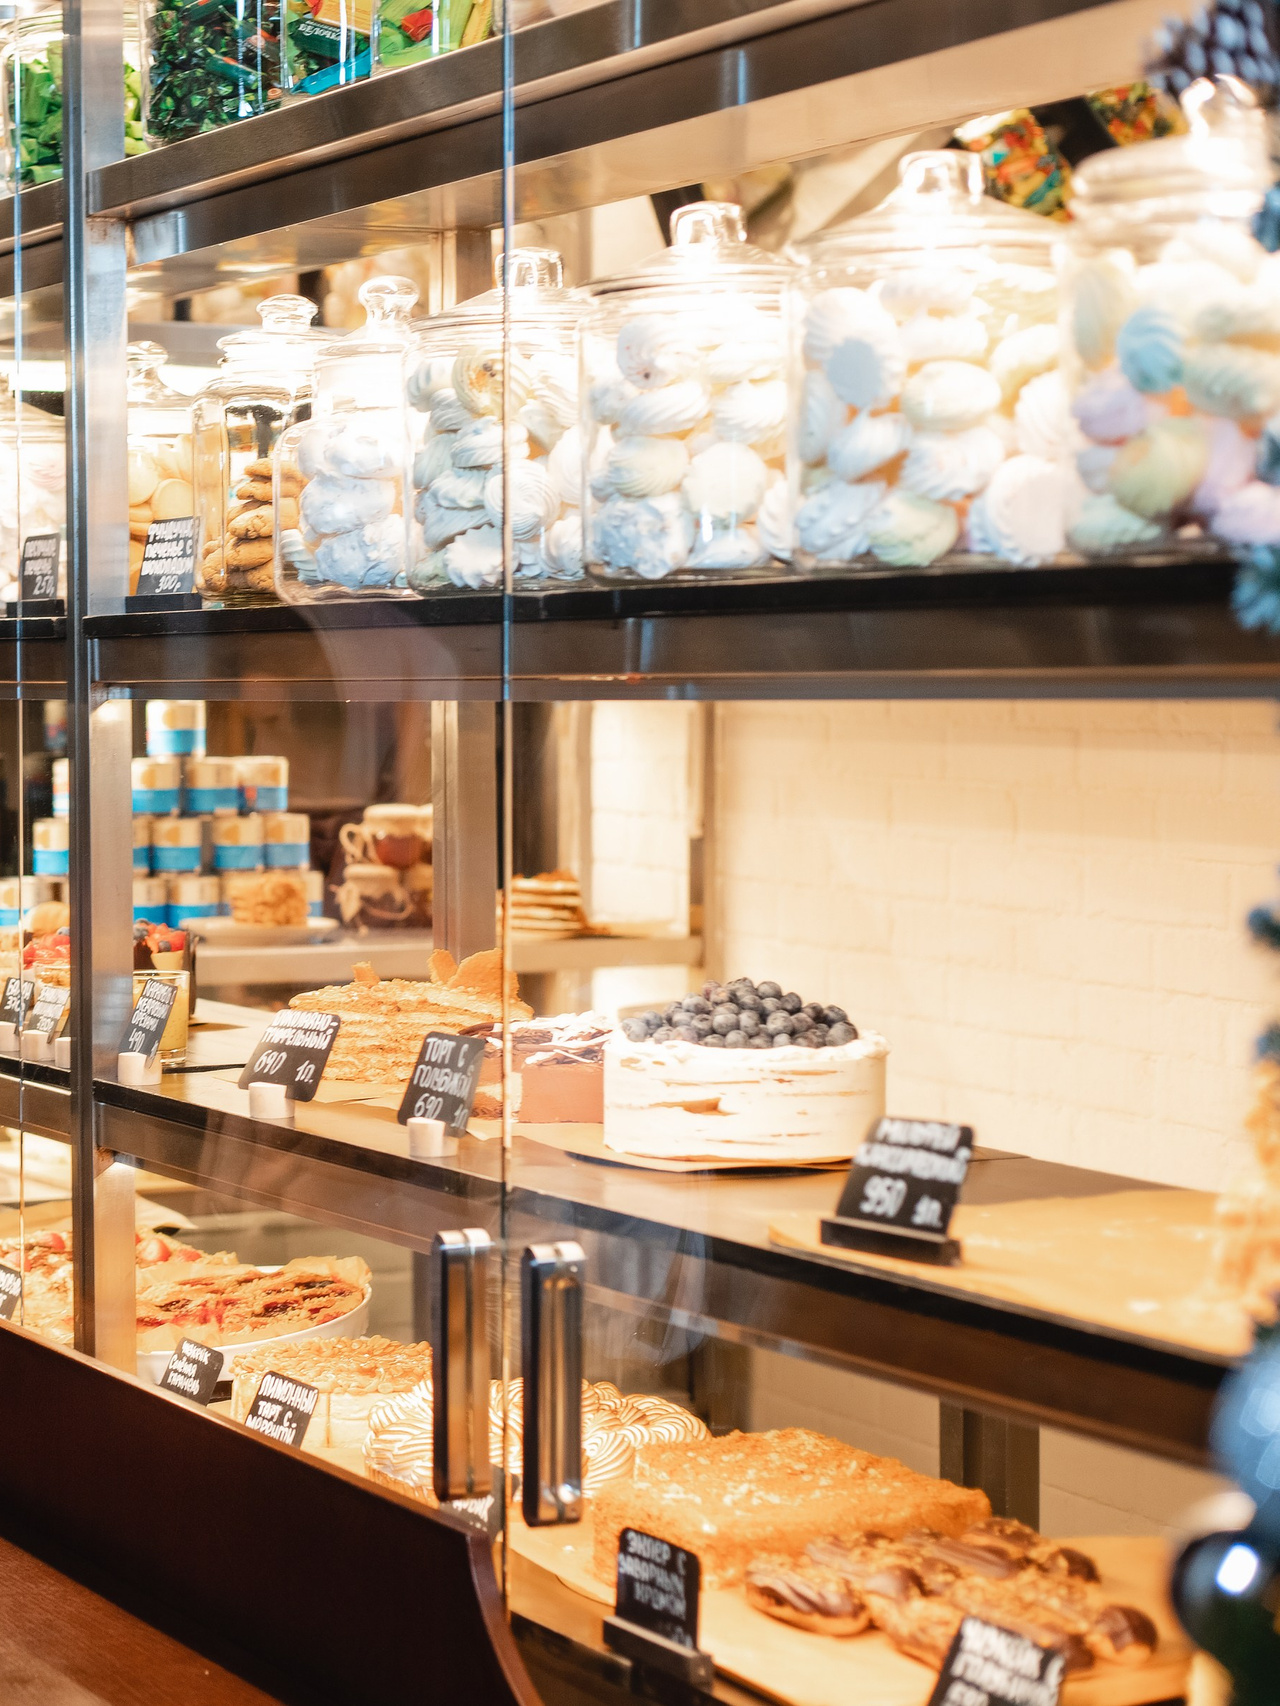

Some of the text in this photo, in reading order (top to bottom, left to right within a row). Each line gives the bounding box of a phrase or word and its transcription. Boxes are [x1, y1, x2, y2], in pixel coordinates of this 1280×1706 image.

[253, 1050, 287, 1075] 690
[424, 1037, 469, 1068] ТОРТ С
[414, 1093, 443, 1120] 690
[258, 1375, 318, 1415] ЛИМОННЫЙ
[258, 1400, 282, 1422] ТАРТ
